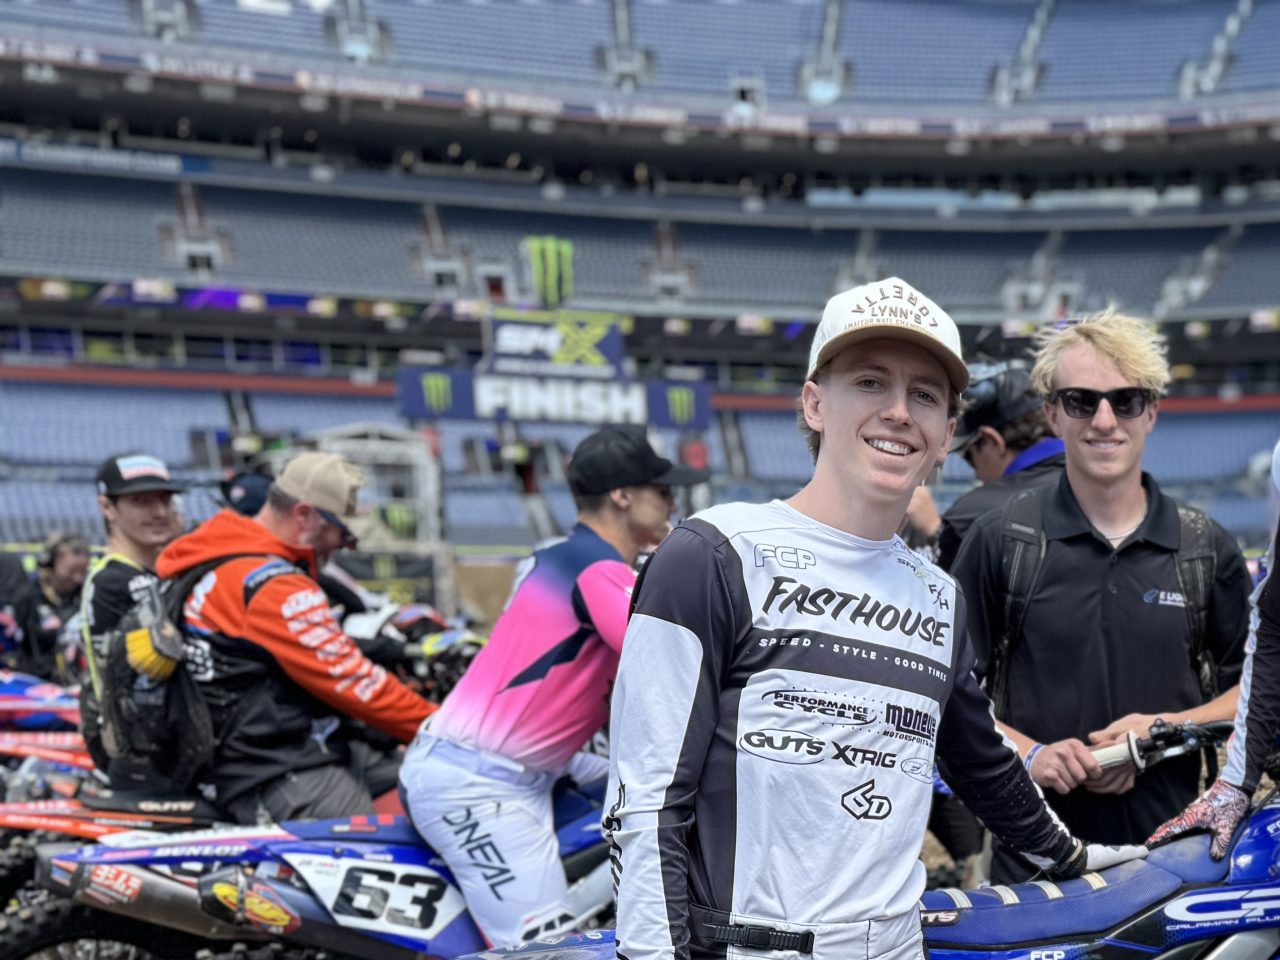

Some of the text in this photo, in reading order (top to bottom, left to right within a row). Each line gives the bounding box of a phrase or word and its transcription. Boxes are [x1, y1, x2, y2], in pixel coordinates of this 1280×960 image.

[872, 304, 922, 325] LYNN'S
[475, 377, 647, 425] FINISH
[754, 543, 816, 570] FCP
[762, 575, 951, 647] FASTHOUSE
[759, 637, 812, 649] SPEED
[832, 643, 877, 661] STYLE
[894, 656, 924, 673] GOOD
[773, 691, 869, 716] PERFORMANCE
[773, 700, 868, 724] CYCLE
[743, 731, 826, 756] GUTS
[831, 740, 897, 768] XTRIG
[332, 866, 448, 931] 63
[1165, 918, 1240, 931] CALAMAN
